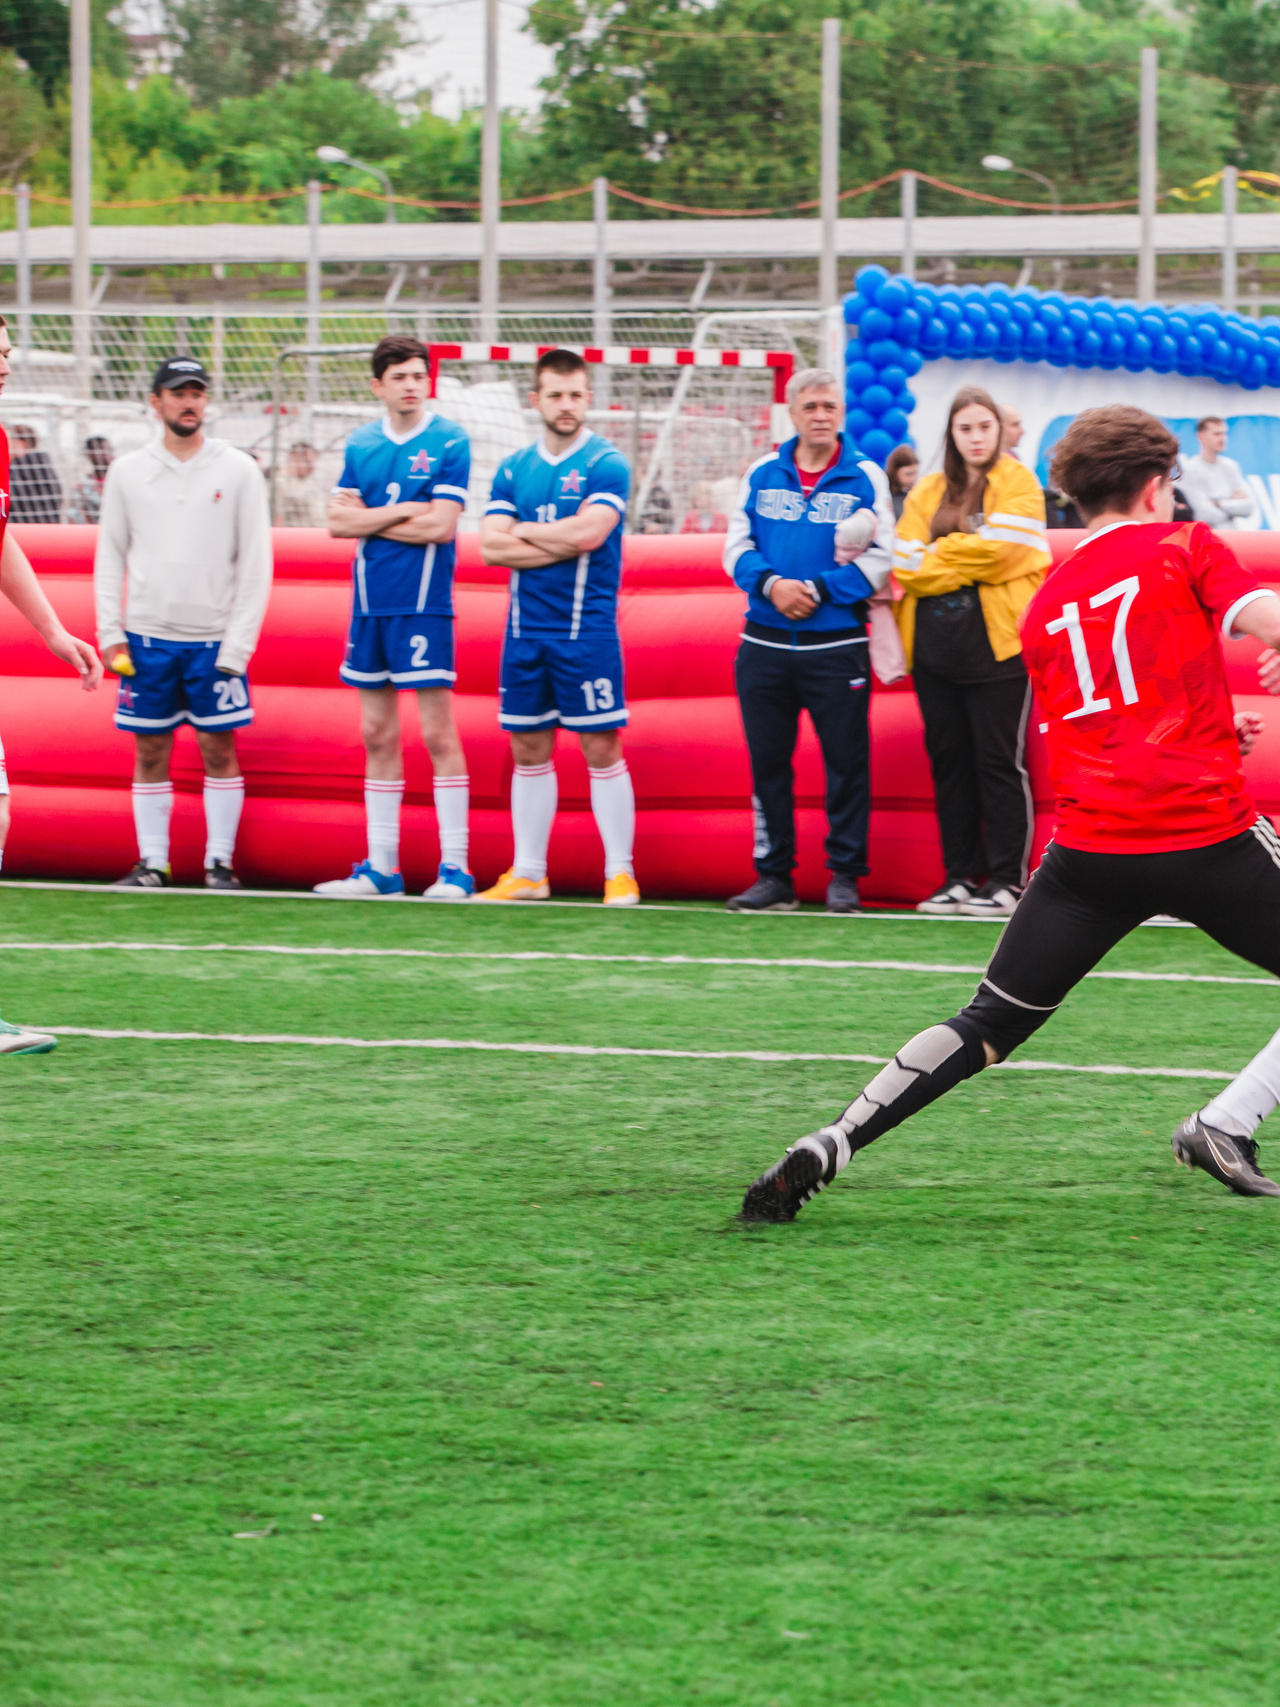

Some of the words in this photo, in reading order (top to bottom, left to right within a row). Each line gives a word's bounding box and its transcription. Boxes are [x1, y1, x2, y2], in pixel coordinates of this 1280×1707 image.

[409, 634, 430, 668] 2
[1045, 575, 1140, 721] 17
[212, 677, 249, 711] 20
[580, 677, 615, 712] 13
